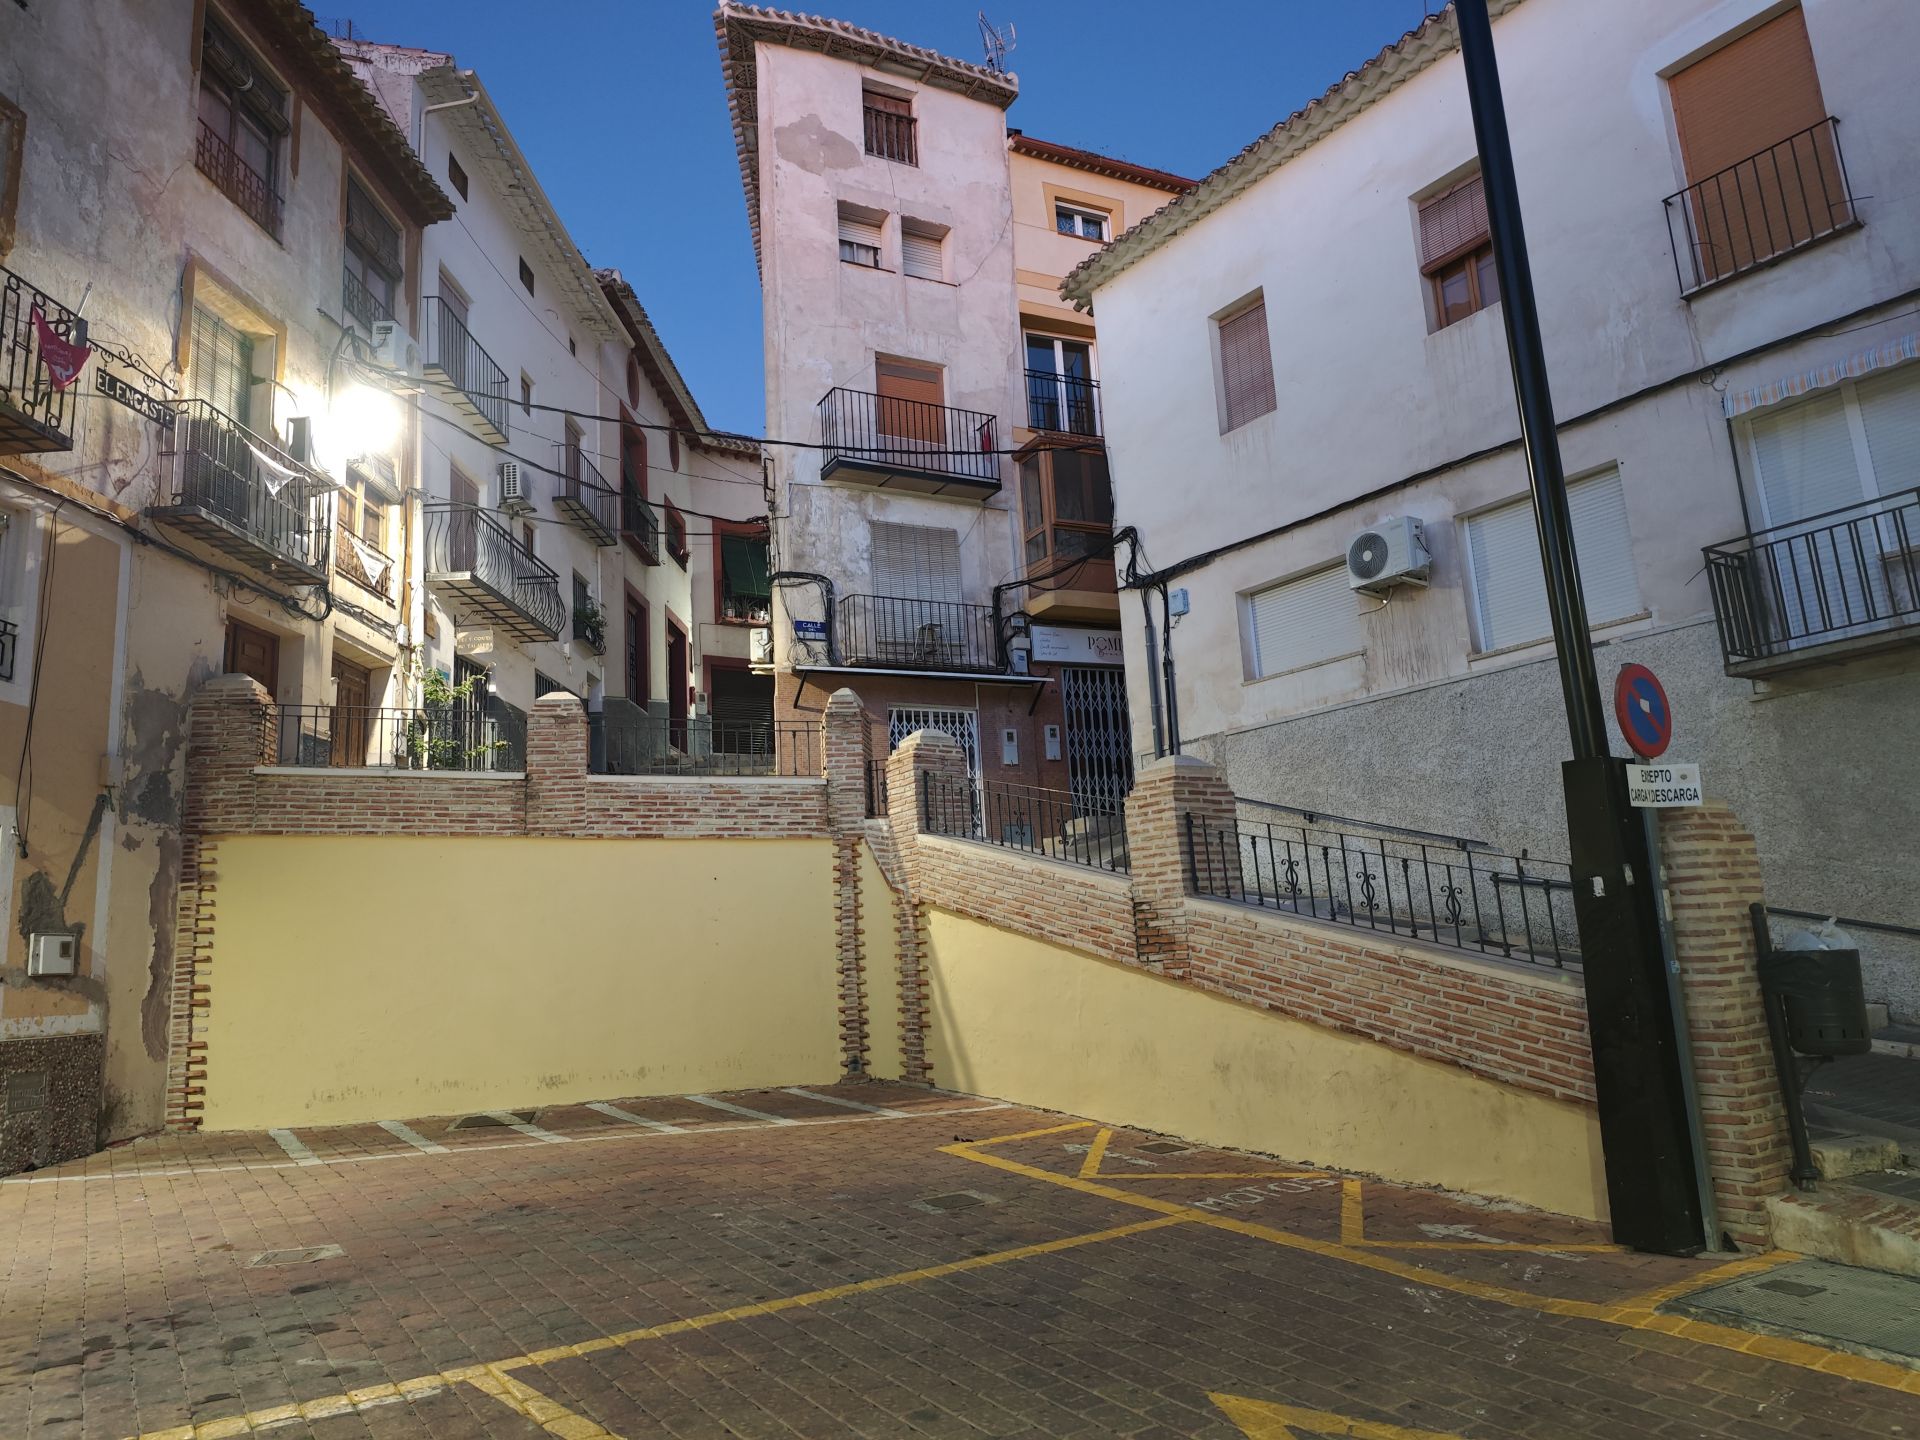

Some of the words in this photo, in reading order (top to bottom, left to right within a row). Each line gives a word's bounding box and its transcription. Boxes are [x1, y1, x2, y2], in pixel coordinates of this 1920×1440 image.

[97, 371, 114, 395] EL
[1630, 788, 1649, 803] CARGA
[1651, 787, 1700, 803] DESCARGA
[1187, 1177, 1339, 1212] MOTOS
